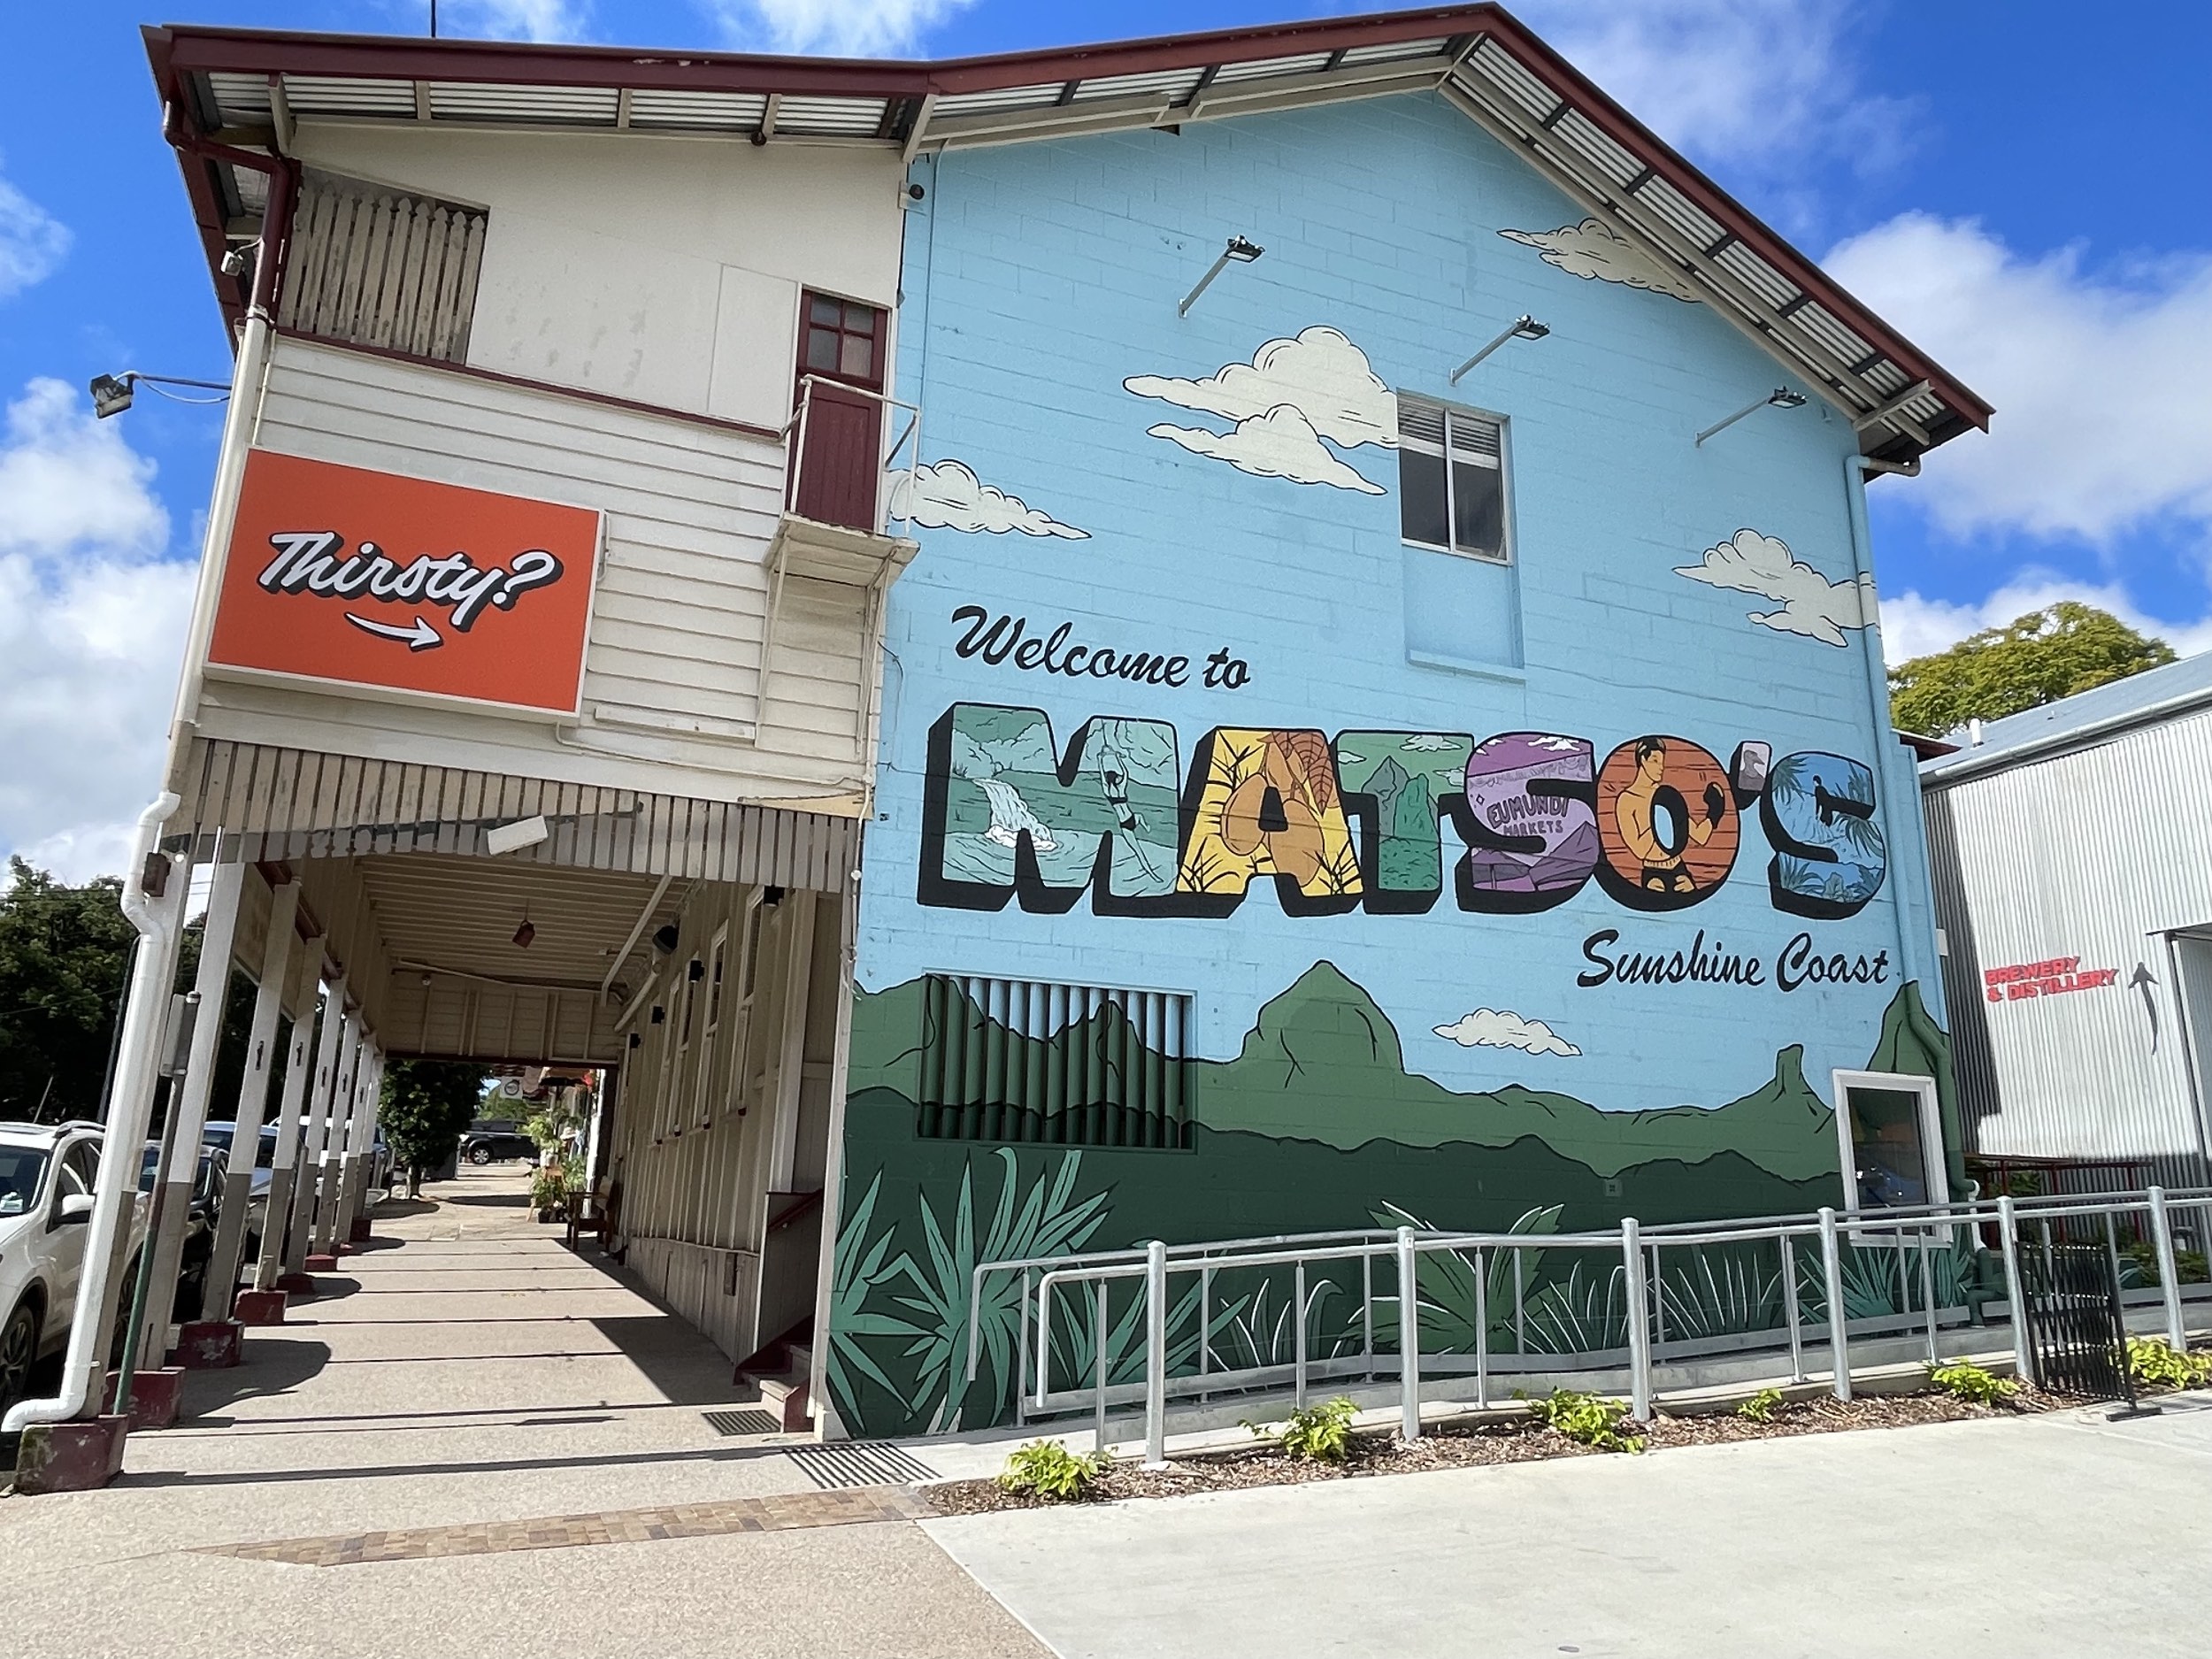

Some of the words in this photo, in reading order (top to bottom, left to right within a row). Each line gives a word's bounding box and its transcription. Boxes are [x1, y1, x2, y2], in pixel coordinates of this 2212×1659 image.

[256, 531, 564, 632] Thirsty?
[951, 605, 1190, 687] Welcome
[1202, 647, 1251, 688] to
[917, 702, 1886, 920] MATSO'S
[1486, 795, 1570, 829] EUMUNDI
[1504, 819, 1563, 836] MARKETS
[1578, 929, 1765, 987] Sunshine
[1777, 933, 1889, 992] Coast
[1985, 956, 2080, 985] BREWERY
[1987, 987, 2004, 1002] &
[2008, 969, 2119, 1001] DISTILLERY
